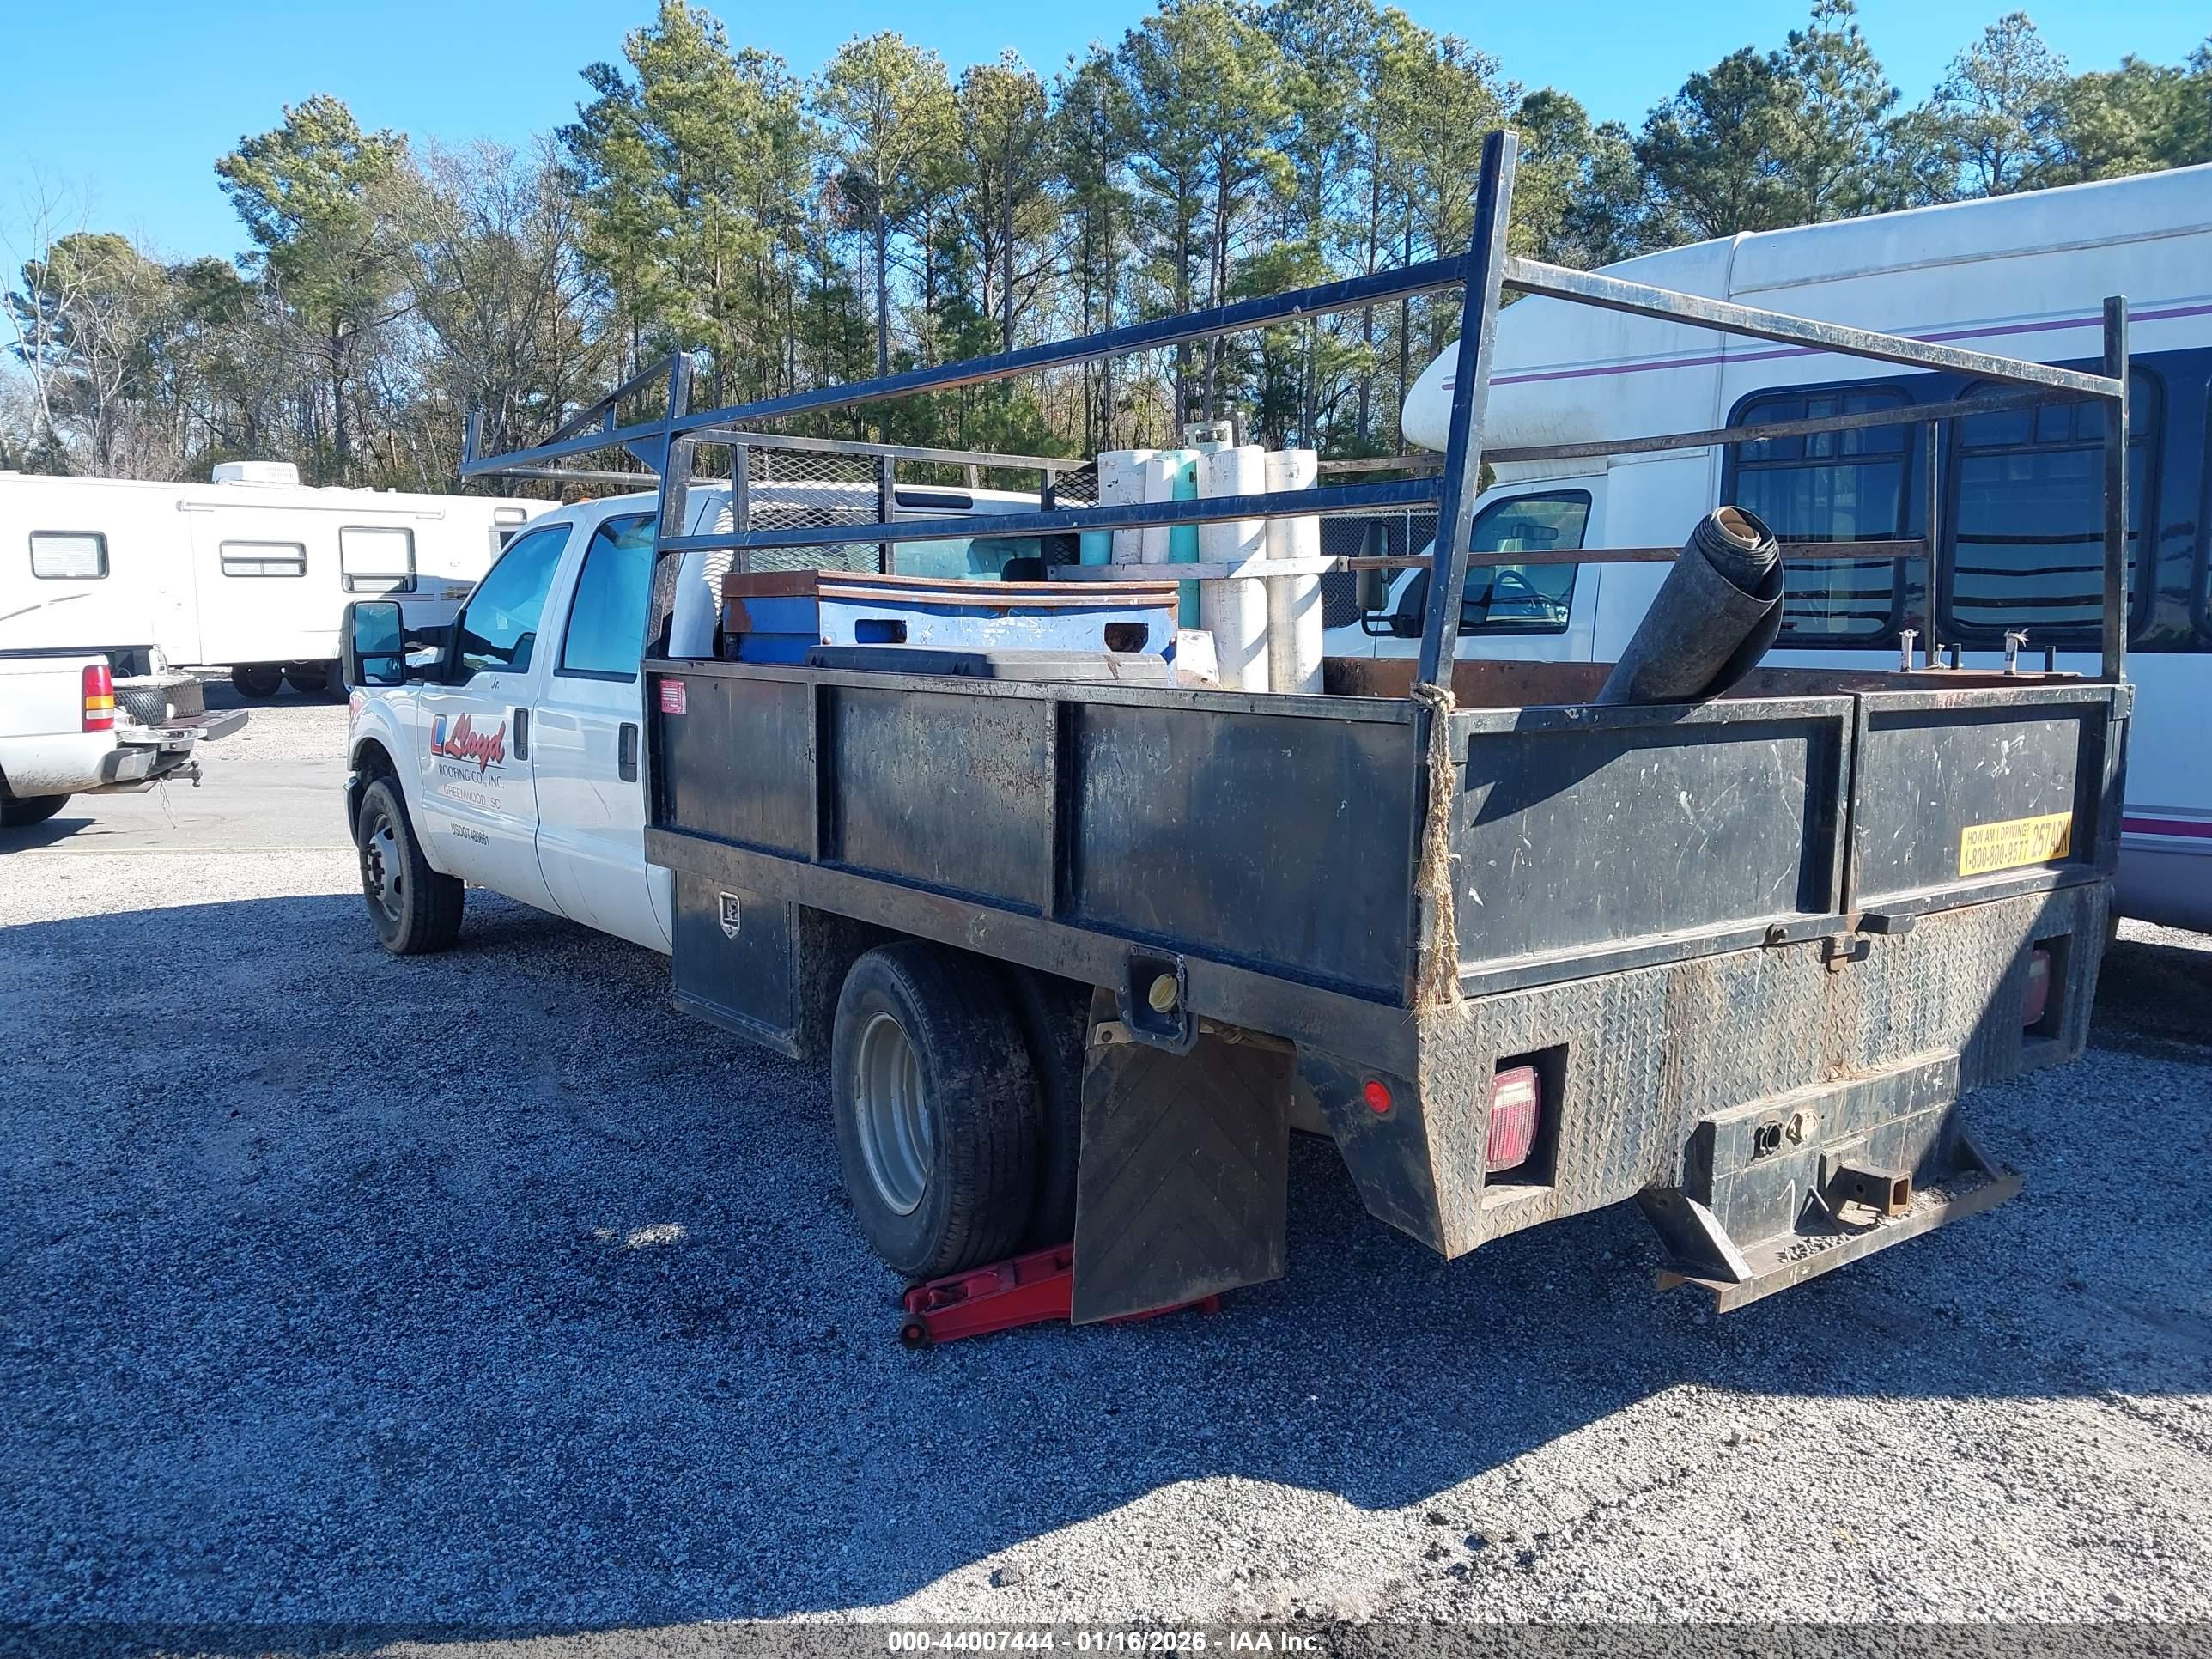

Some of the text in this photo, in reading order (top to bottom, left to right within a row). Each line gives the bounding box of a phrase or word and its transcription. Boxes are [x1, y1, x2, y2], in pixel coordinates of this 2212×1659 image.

[490, 677, 500, 690] Jr.
[445, 712, 507, 774] Lloyd
[439, 763, 471, 782] ROOFING
[488, 776, 505, 789] INC.
[443, 784, 501, 810] GREENWOOD, SC
[1966, 830, 1984, 845] HOW
[1984, 829, 1995, 842] AM
[2001, 823, 2030, 842] DRIVING?
[1965, 839, 2029, 871] 1-800-800-9577
